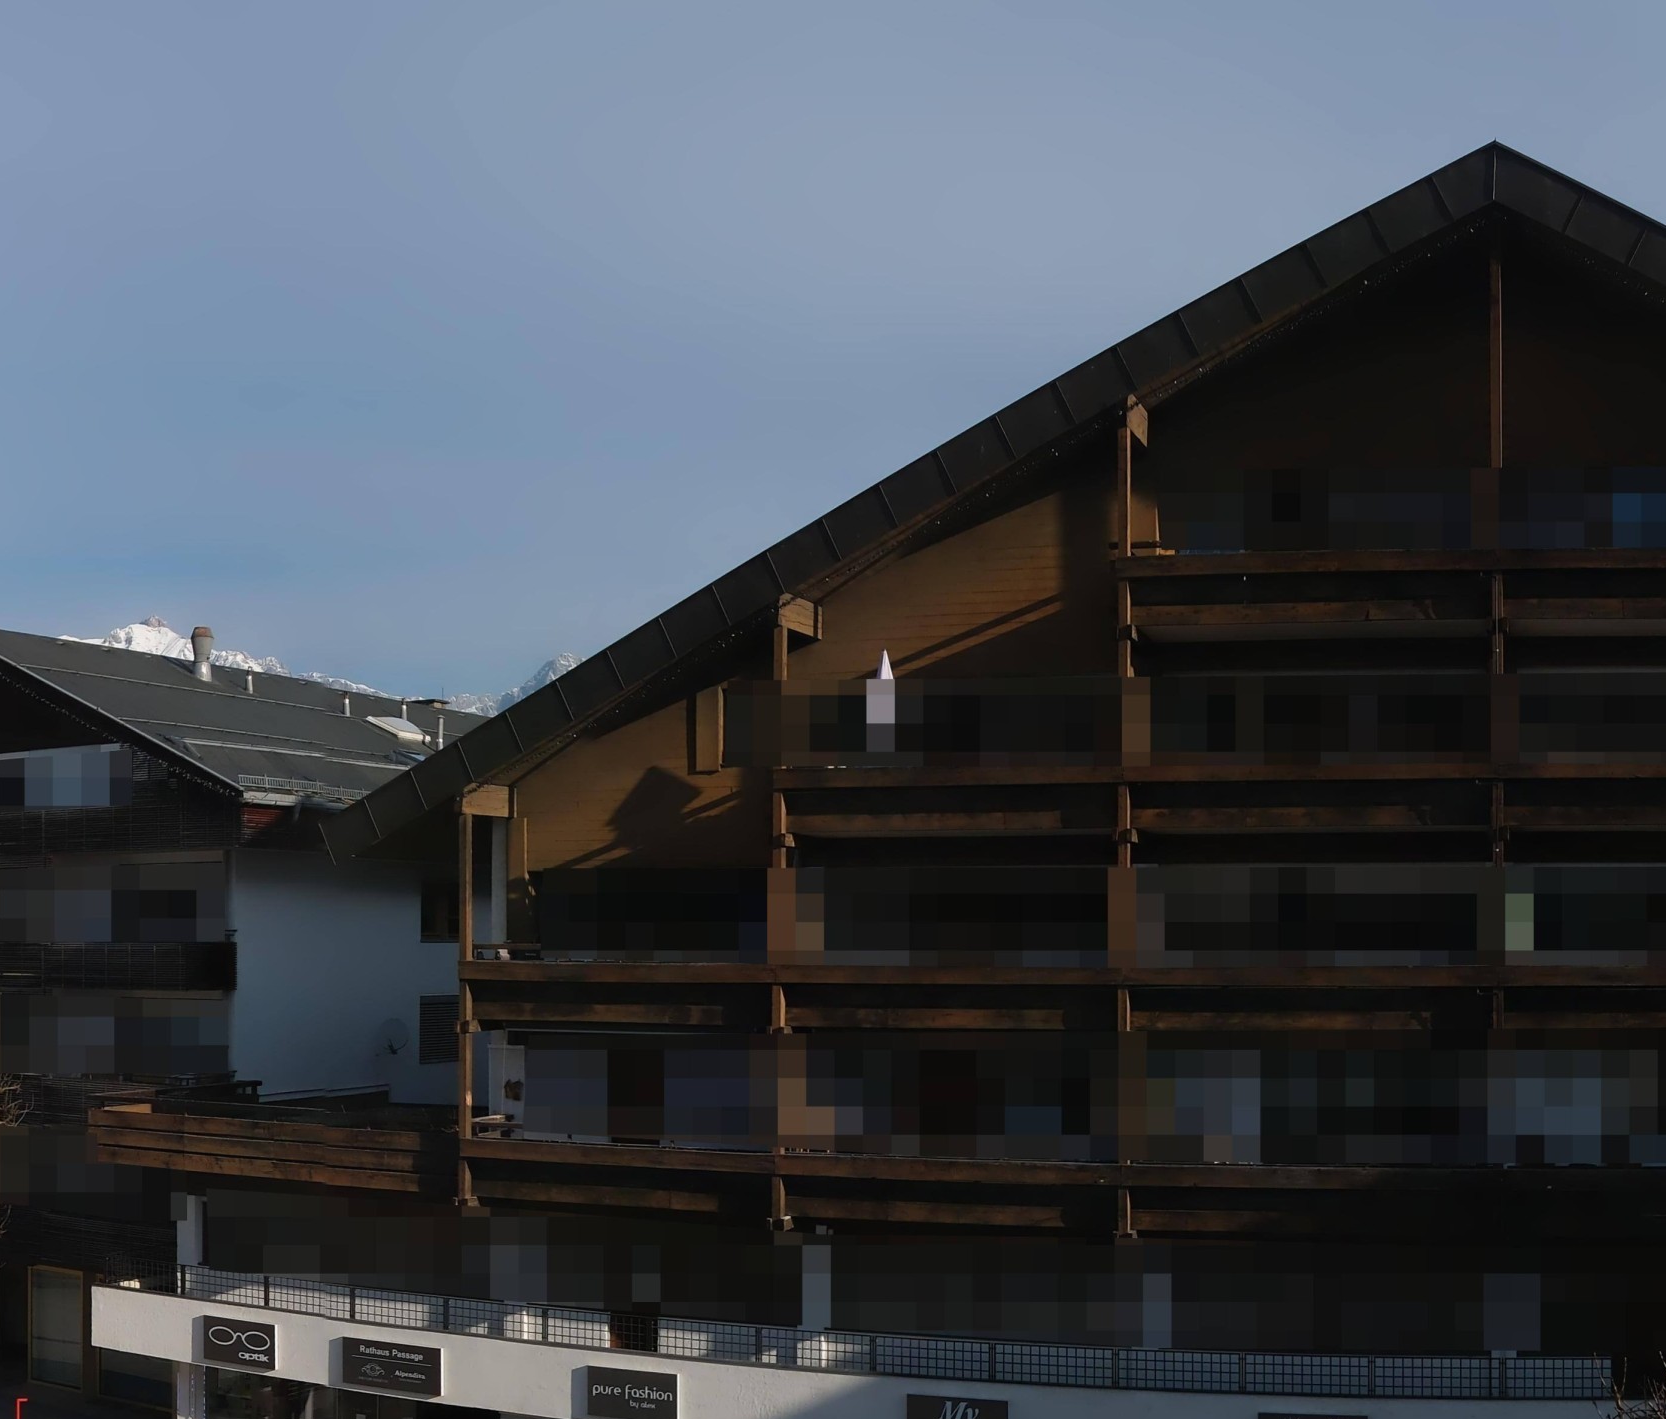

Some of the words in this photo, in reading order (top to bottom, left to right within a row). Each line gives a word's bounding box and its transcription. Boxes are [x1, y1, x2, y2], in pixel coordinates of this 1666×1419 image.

[238, 1351, 270, 1363] optik
[359, 1344, 390, 1357] Rathaus
[391, 1349, 424, 1362] Passage
[592, 1384, 621, 1397] pure
[625, 1384, 673, 1401] fashion
[629, 1399, 639, 1409] by
